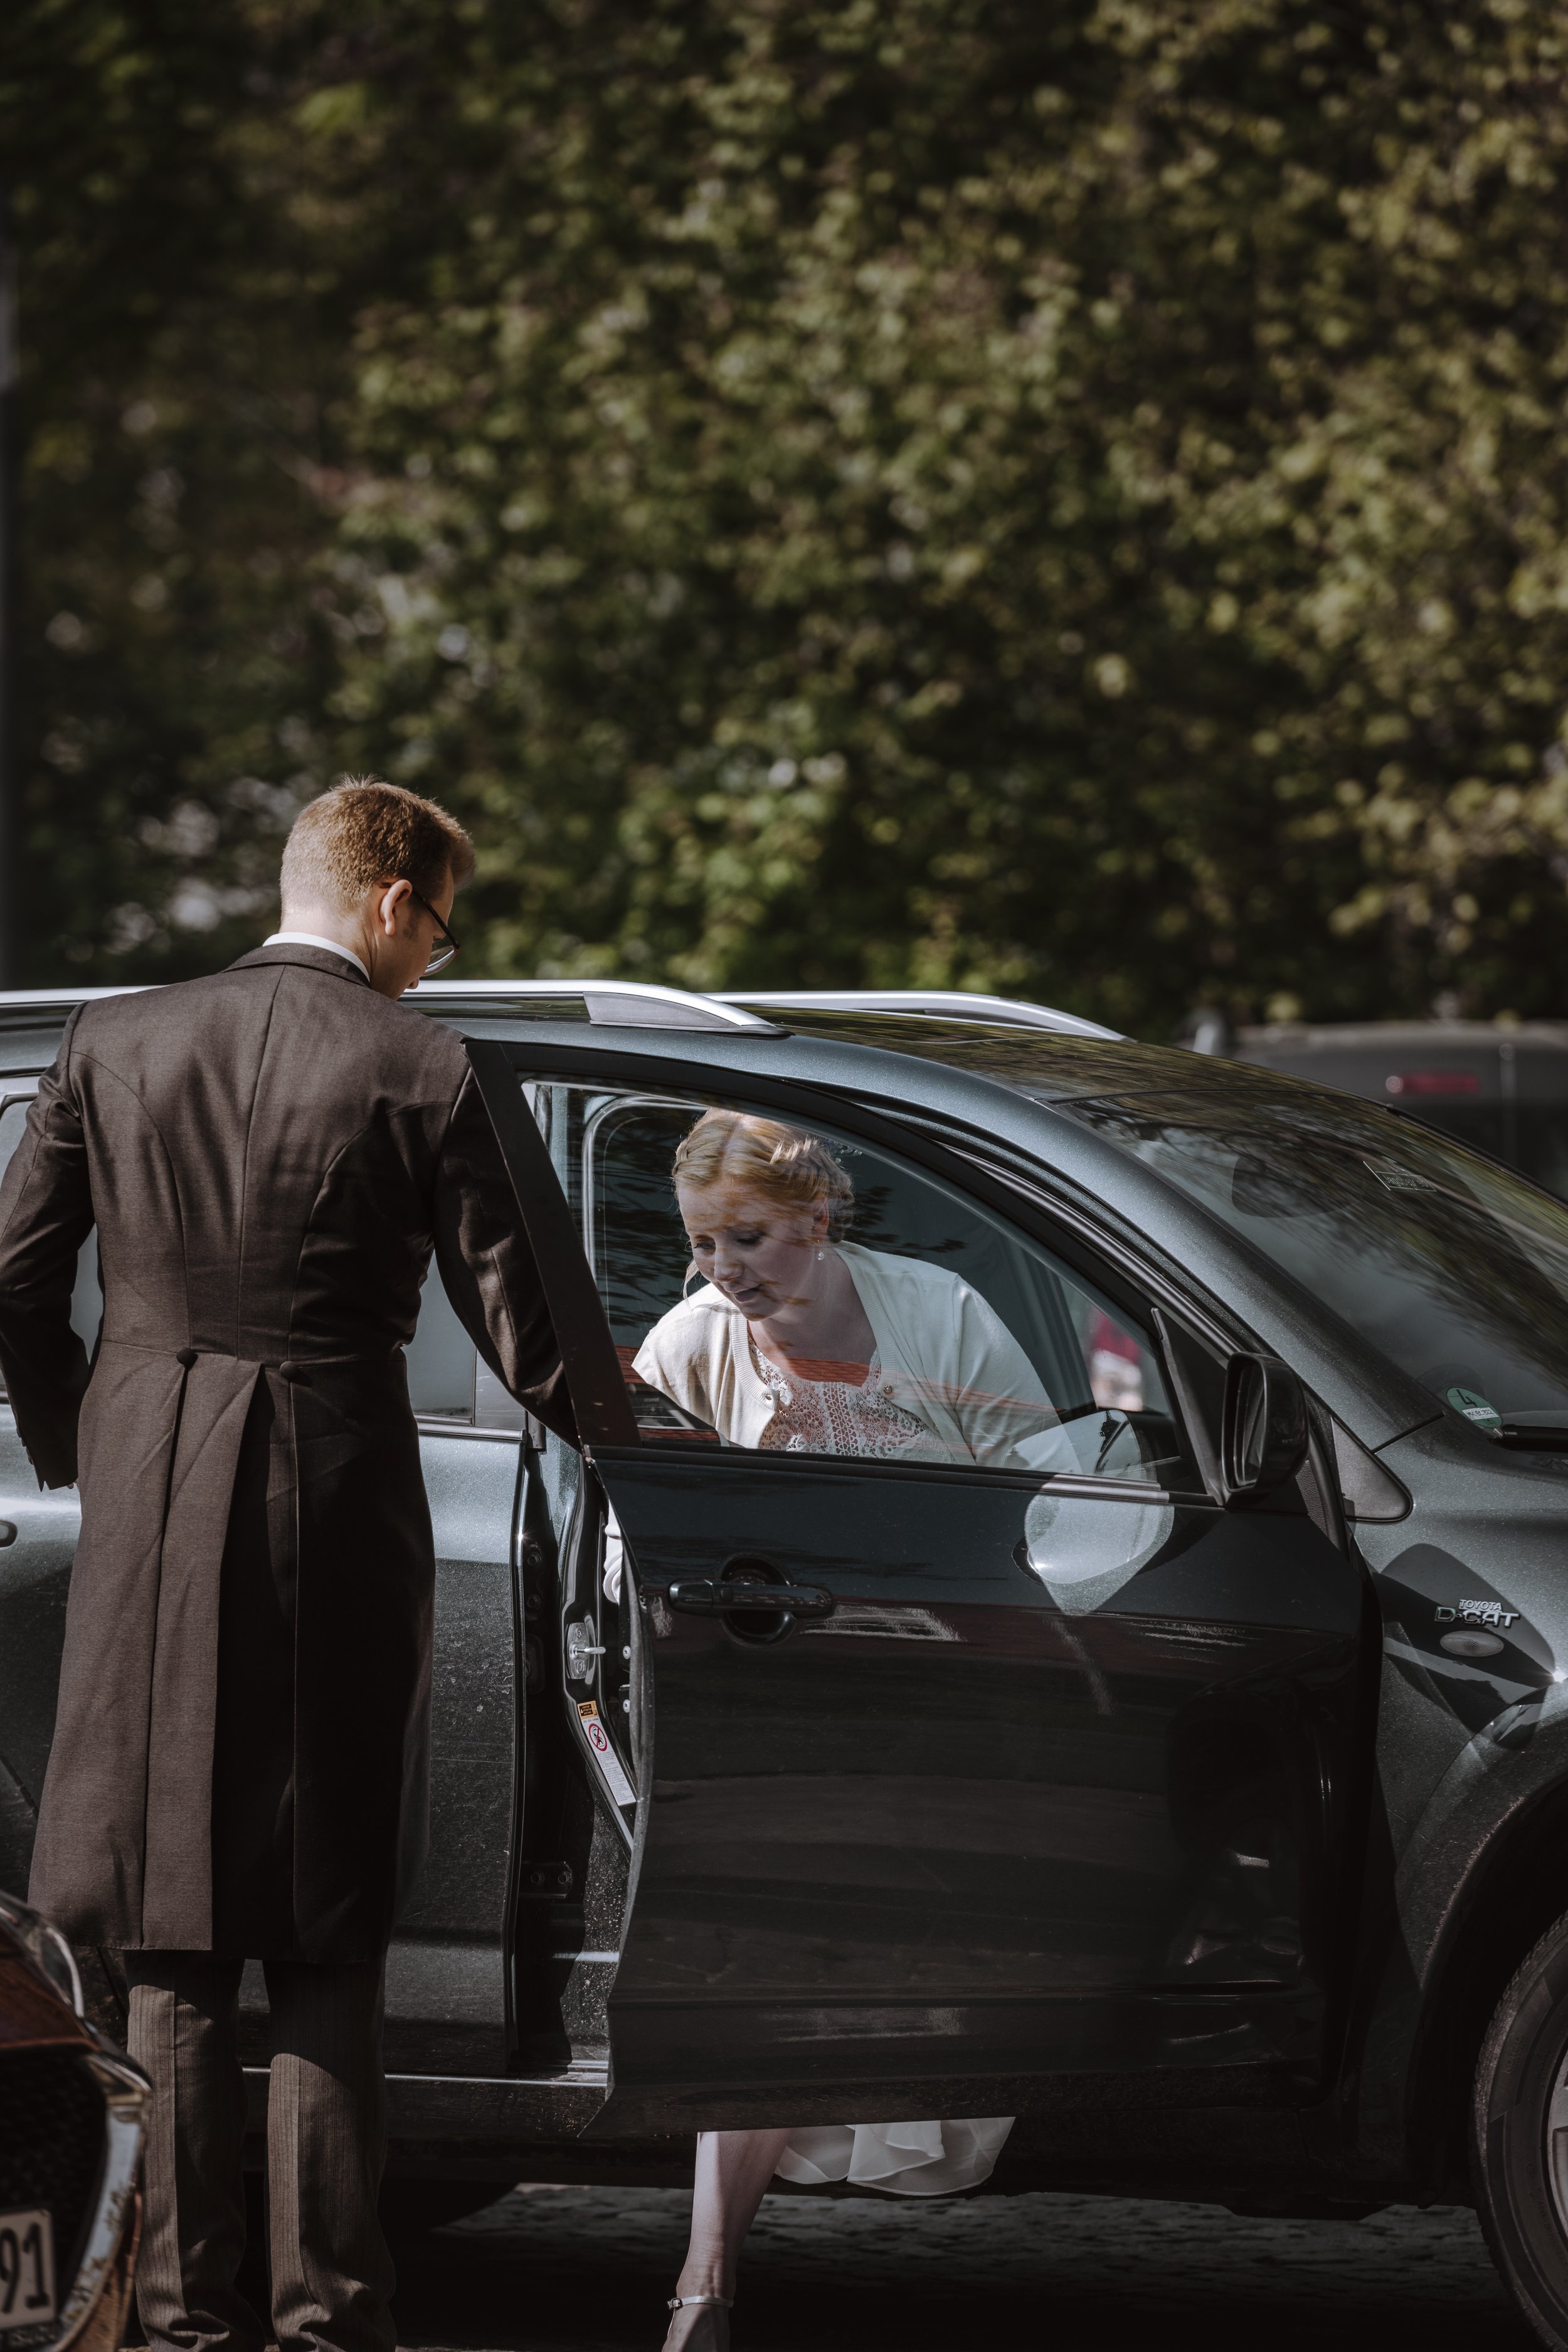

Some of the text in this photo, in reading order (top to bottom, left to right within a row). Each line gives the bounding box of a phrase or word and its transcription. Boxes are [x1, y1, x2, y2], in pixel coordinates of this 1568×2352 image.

[1456, 1389, 1478, 1407] 4
[1459, 1599, 1502, 1611] TOYOTA
[1434, 1606, 1520, 1628] D-CAT
[0, 2222, 50, 2313] 91
